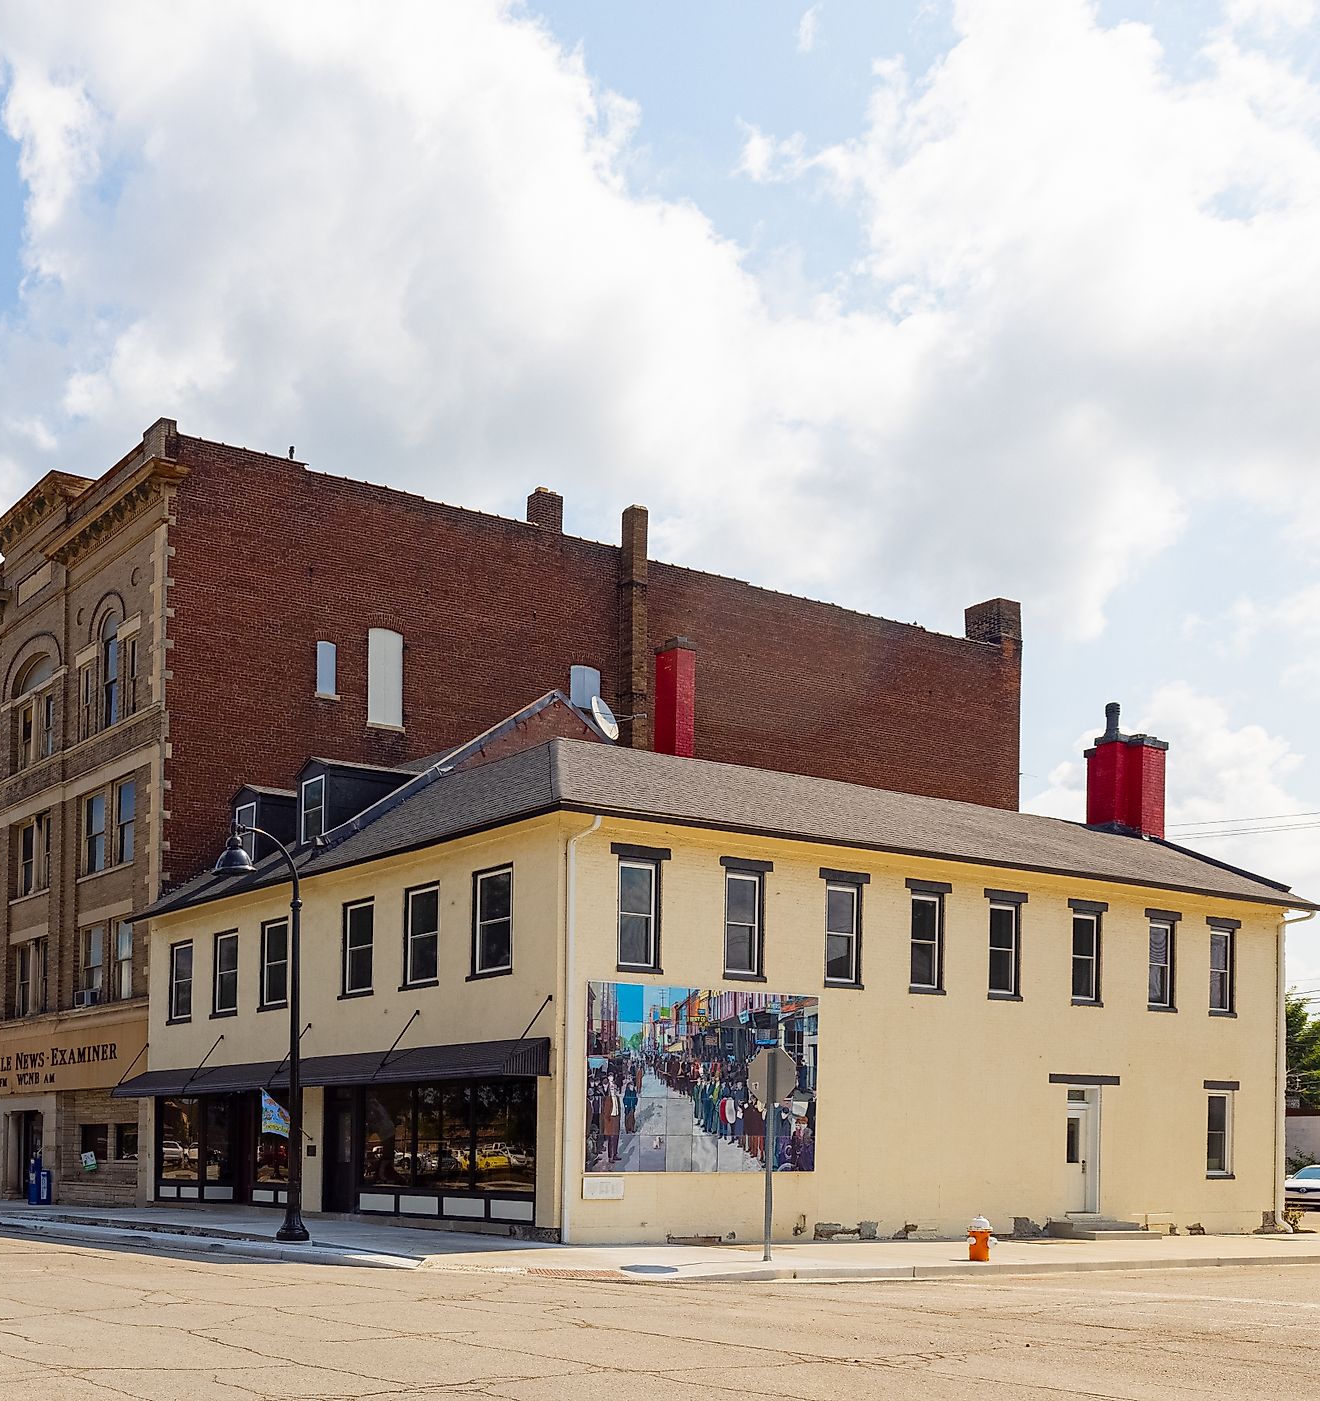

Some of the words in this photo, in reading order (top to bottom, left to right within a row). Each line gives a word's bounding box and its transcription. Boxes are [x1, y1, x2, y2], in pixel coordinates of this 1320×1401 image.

[0, 1078, 8, 1087] FM
[16, 1072, 40, 1086] WCNB
[43, 1073, 56, 1084] AM
